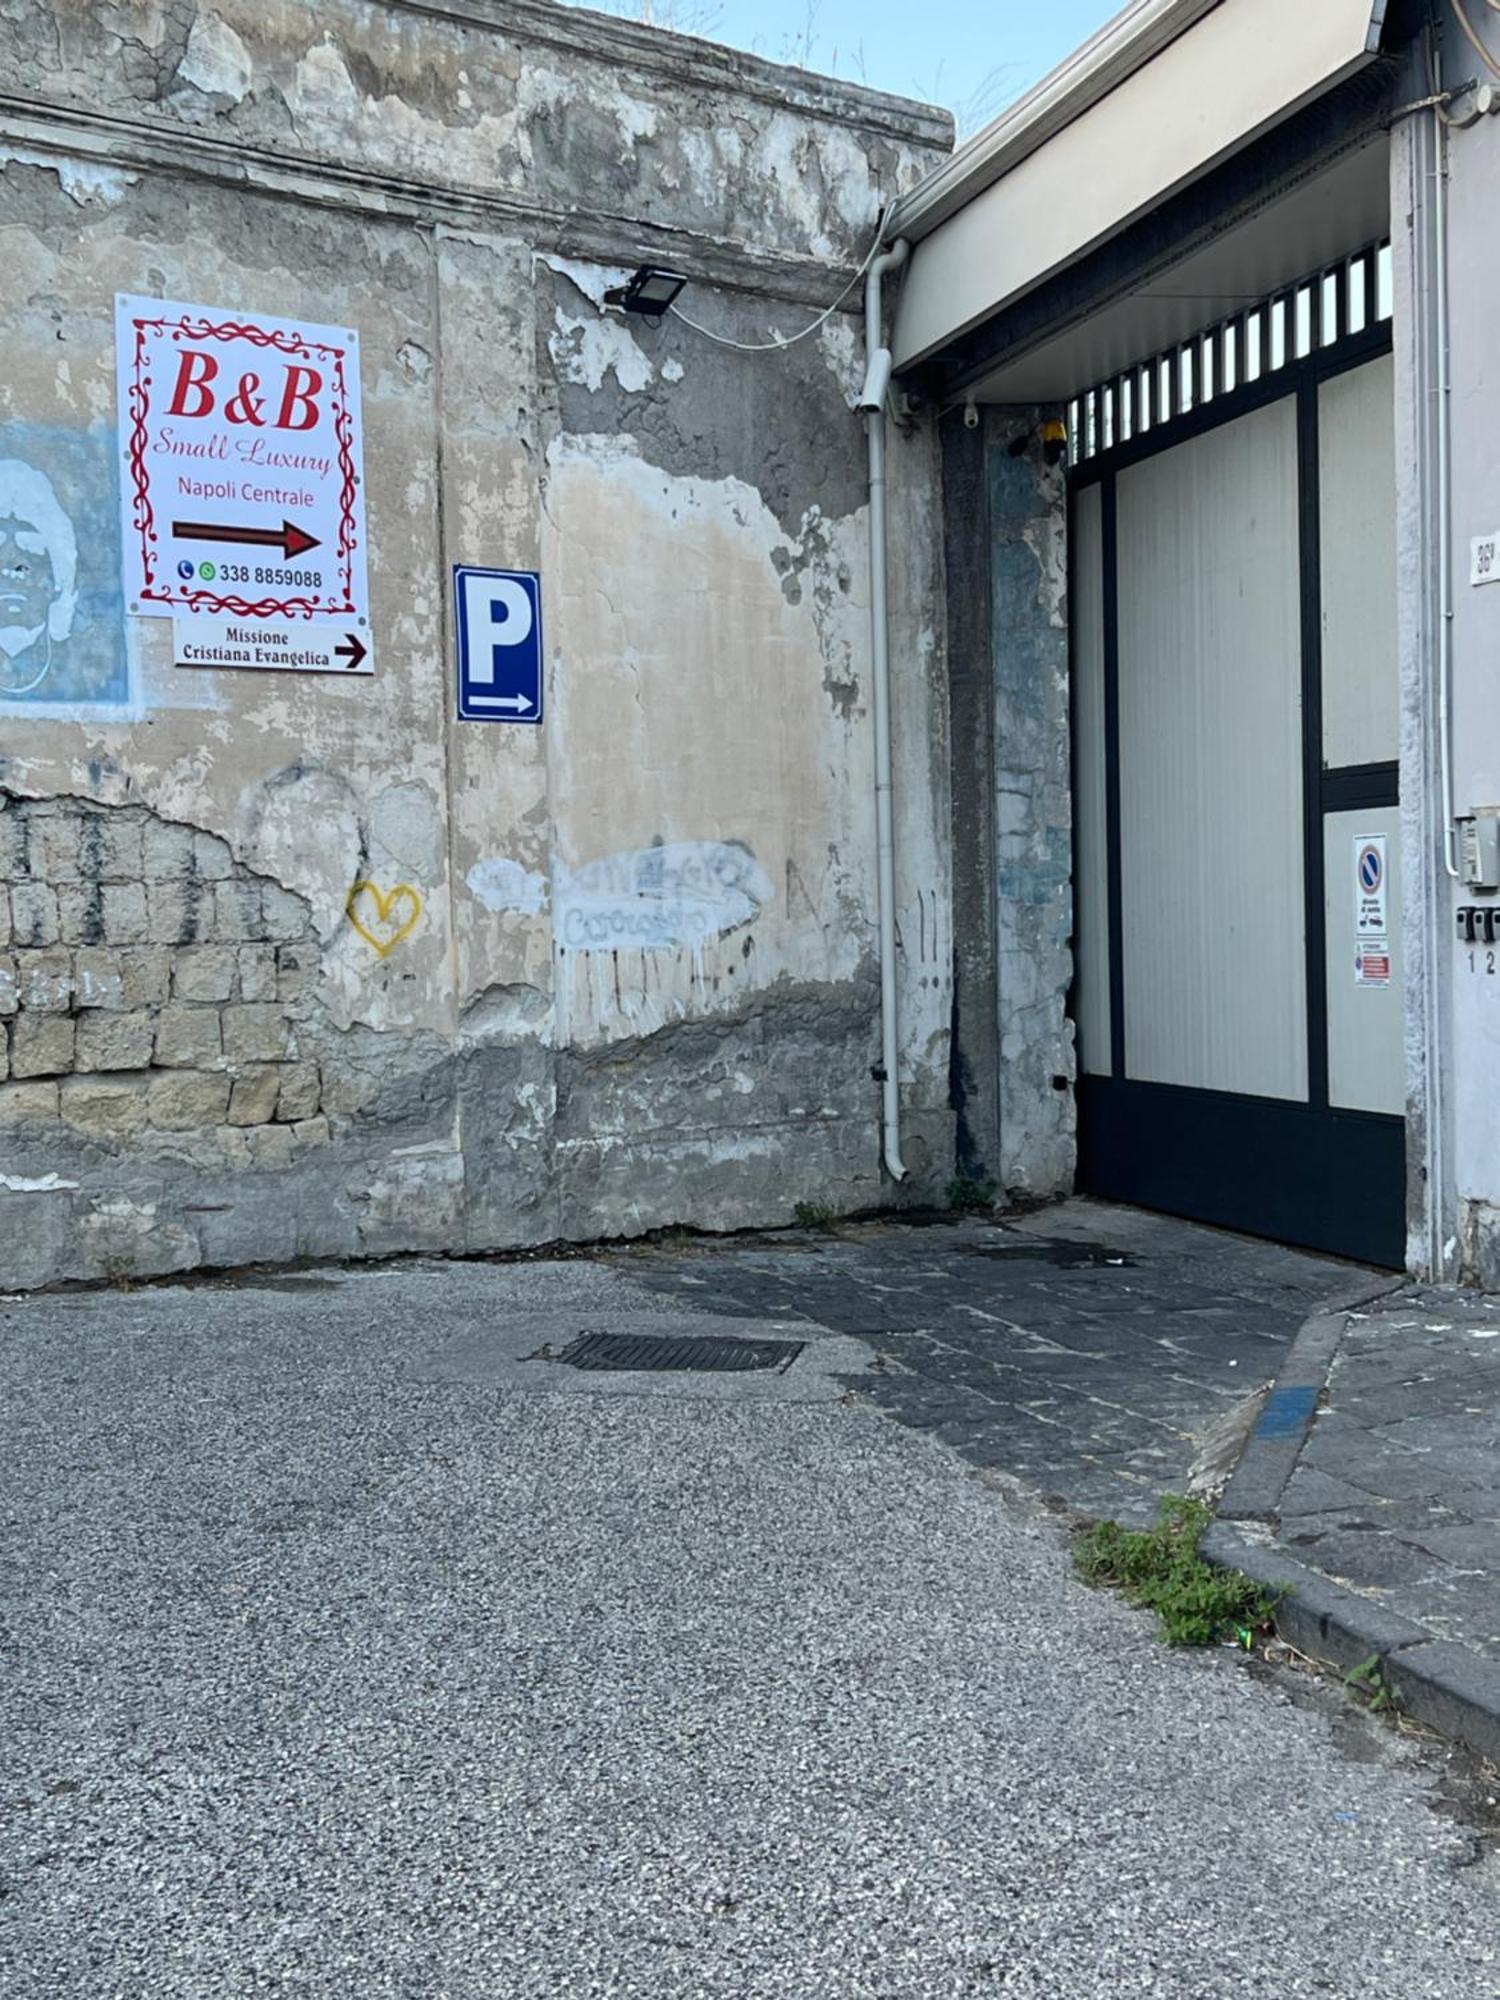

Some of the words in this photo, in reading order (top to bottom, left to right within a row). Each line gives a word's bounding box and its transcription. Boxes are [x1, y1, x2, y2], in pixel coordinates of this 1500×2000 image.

[162, 349, 323, 431] B&B
[153, 427, 228, 461] Small
[235, 438, 334, 480] Luxury
[178, 475, 237, 500] Napoli
[241, 483, 315, 508] Centrale
[220, 564, 250, 582] 338
[255, 567, 322, 588] 8859088
[226, 626, 289, 646] Missione
[464, 575, 532, 685] P
[183, 643, 251, 662] Cristiana
[255, 648, 330, 667] Evangelica
[1468, 950, 1475, 974] 1
[1486, 950, 1496, 975] 2
